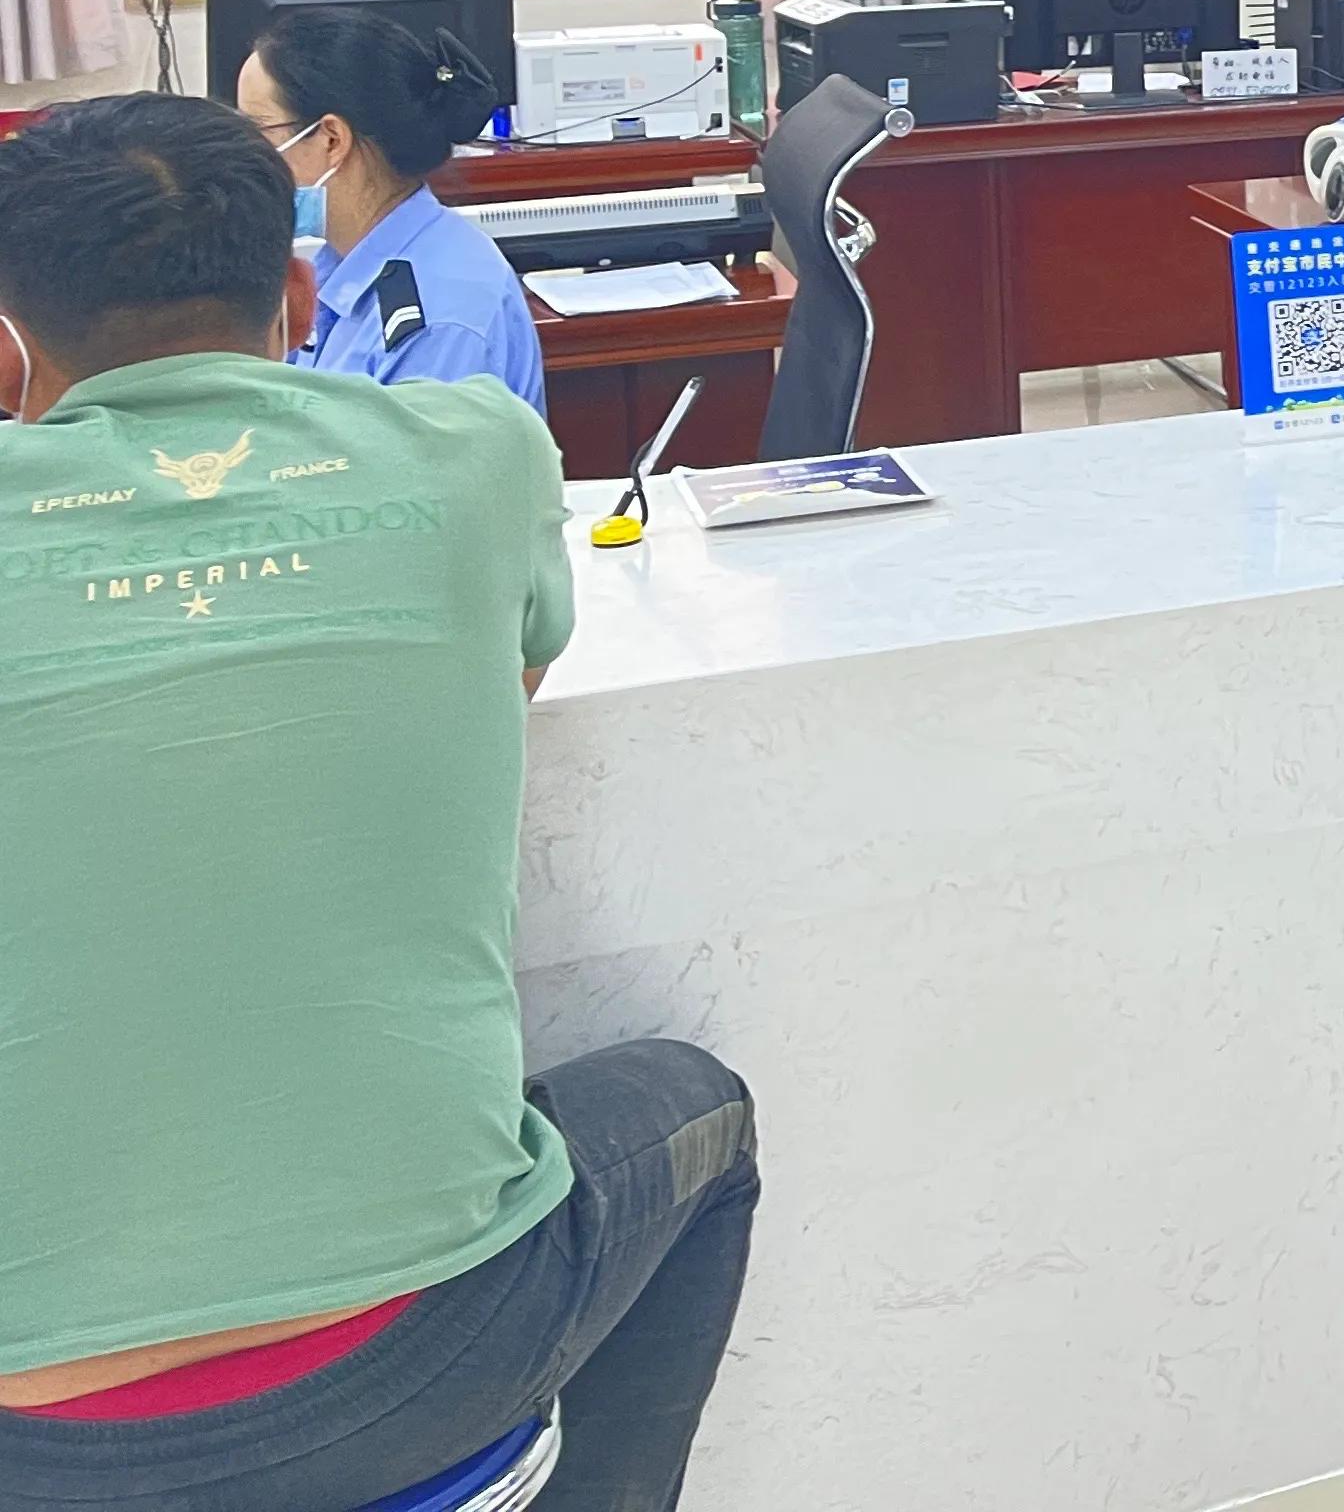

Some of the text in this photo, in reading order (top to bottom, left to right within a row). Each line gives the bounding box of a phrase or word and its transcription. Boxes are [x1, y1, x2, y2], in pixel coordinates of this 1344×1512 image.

[31, 488, 138, 514] EPERNAY
[269, 457, 350, 483] FRANCE
[181, 498, 445, 558] CHANDON
[86, 553, 312, 602] IMPERIAL
